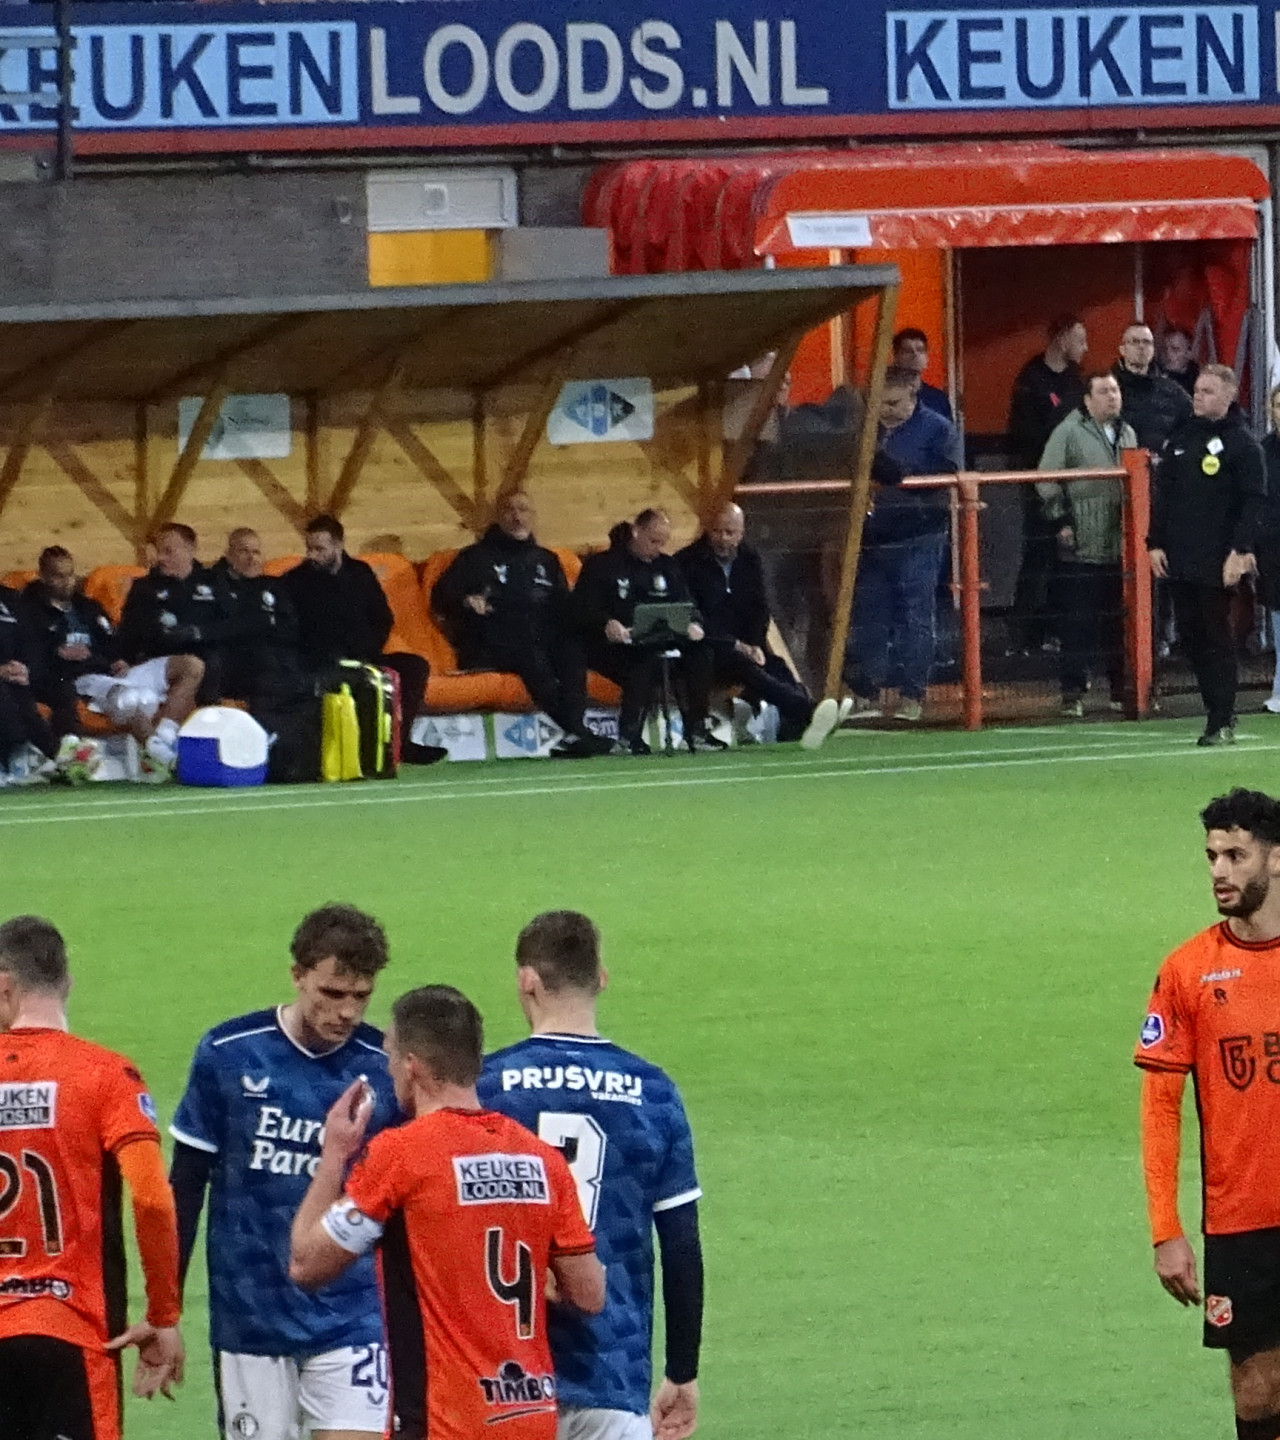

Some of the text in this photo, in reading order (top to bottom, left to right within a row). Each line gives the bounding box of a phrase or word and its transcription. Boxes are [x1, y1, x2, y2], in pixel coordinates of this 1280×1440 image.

[370, 20, 828, 115] LOODS.NL
[896, 9, 1247, 101] KEUKEN
[0, 1150, 62, 1256] 21
[460, 1160, 541, 1182] KEUKEN
[486, 1227, 536, 1339] 4
